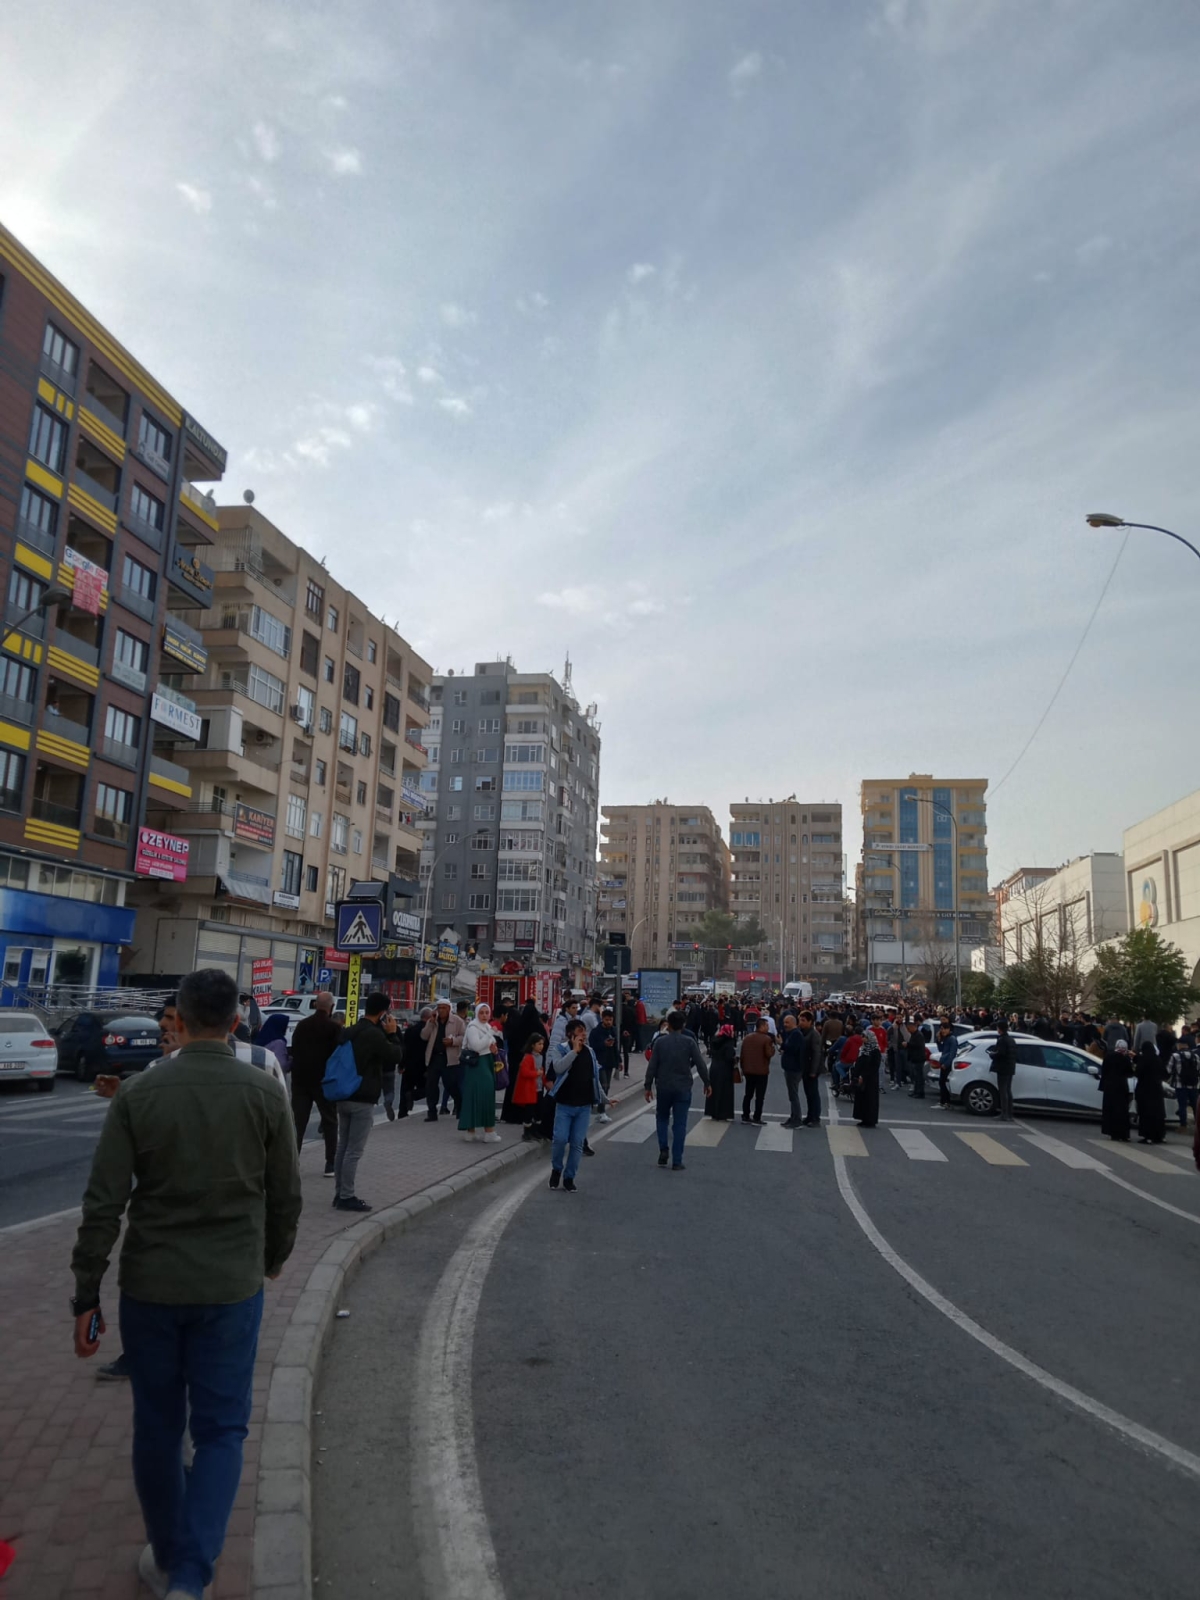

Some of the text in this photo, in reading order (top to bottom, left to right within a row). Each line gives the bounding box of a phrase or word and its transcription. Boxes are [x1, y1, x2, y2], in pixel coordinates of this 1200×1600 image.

[154, 697, 201, 731] FORMEST
[148, 833, 190, 855] ZEYNEP
[320, 969, 329, 982] P
[348, 971, 359, 1026] YAYA GEÇİ
